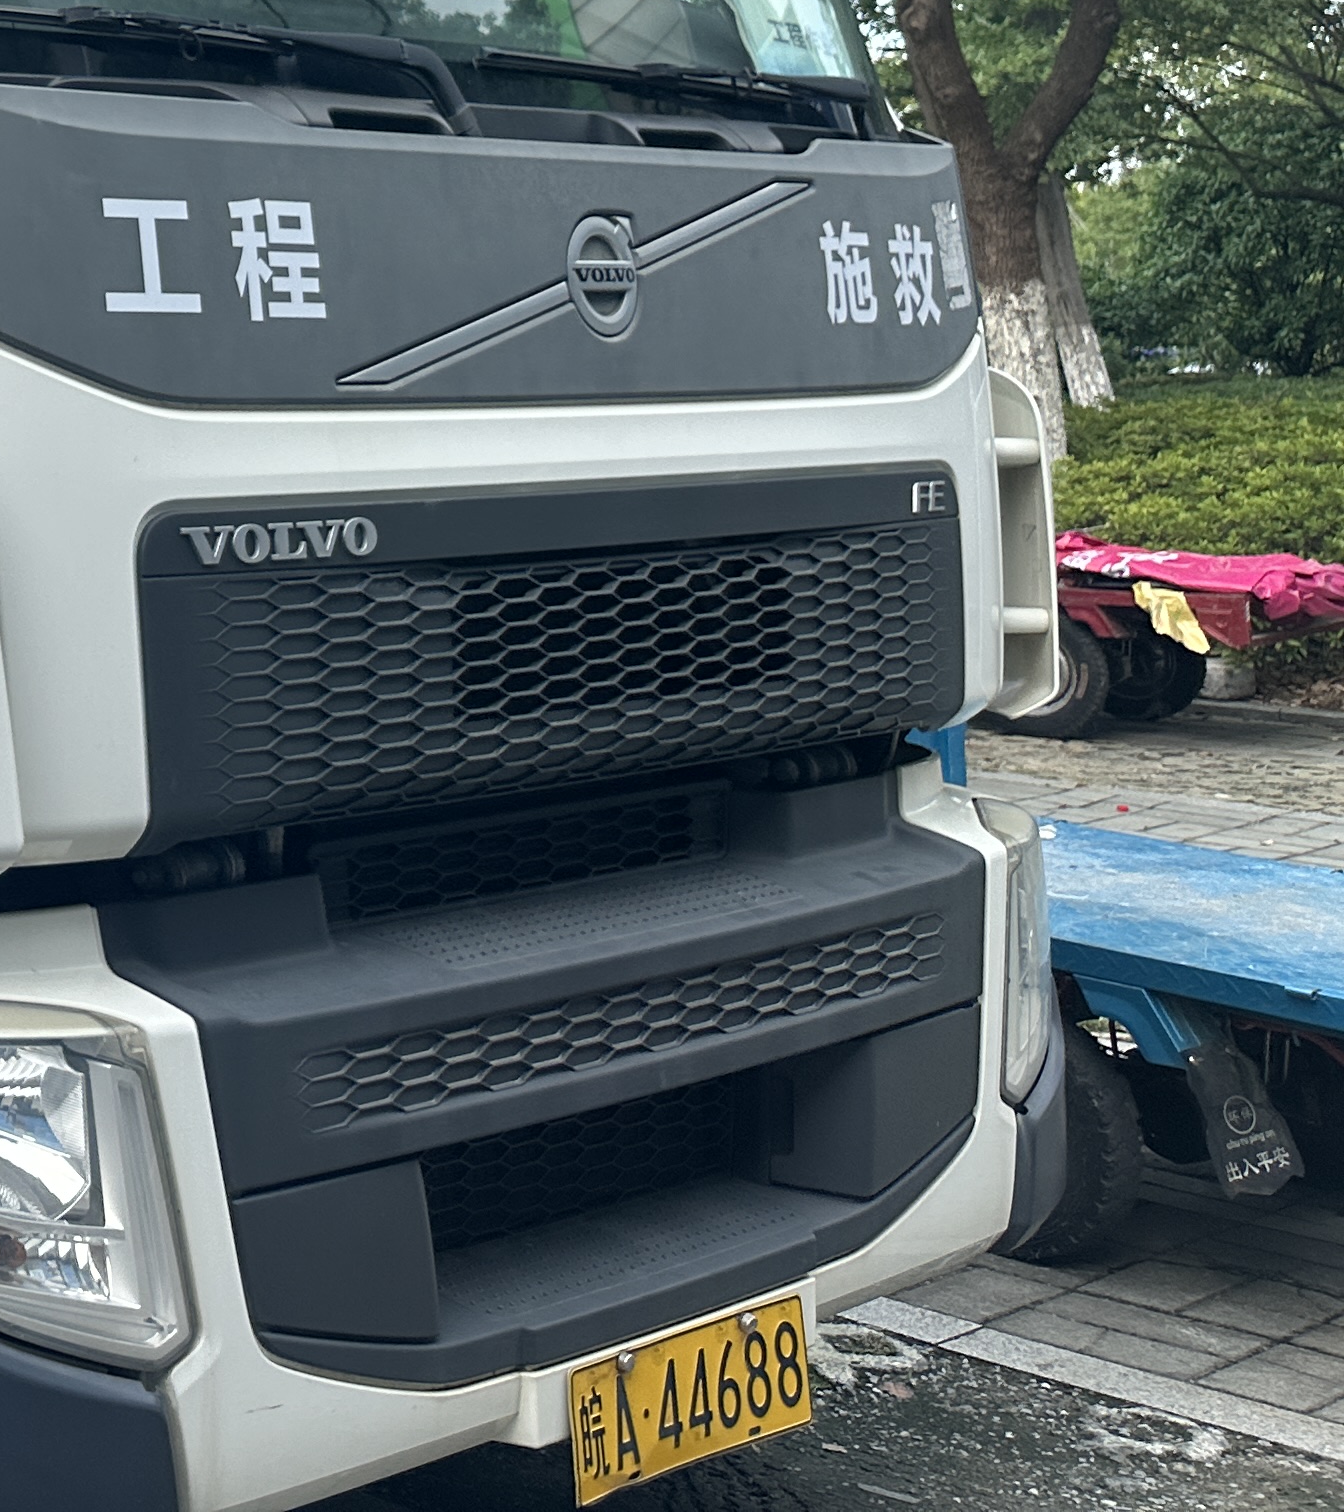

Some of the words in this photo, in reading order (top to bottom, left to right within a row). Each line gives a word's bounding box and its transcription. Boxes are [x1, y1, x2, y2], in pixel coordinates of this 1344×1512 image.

[102, 197, 326, 321] 工程
[573, 268, 635, 283] VOLVO
[912, 480, 946, 513] FE
[179, 516, 379, 566] VOLVO
[1225, 1147, 1291, 1182] 出入平安
